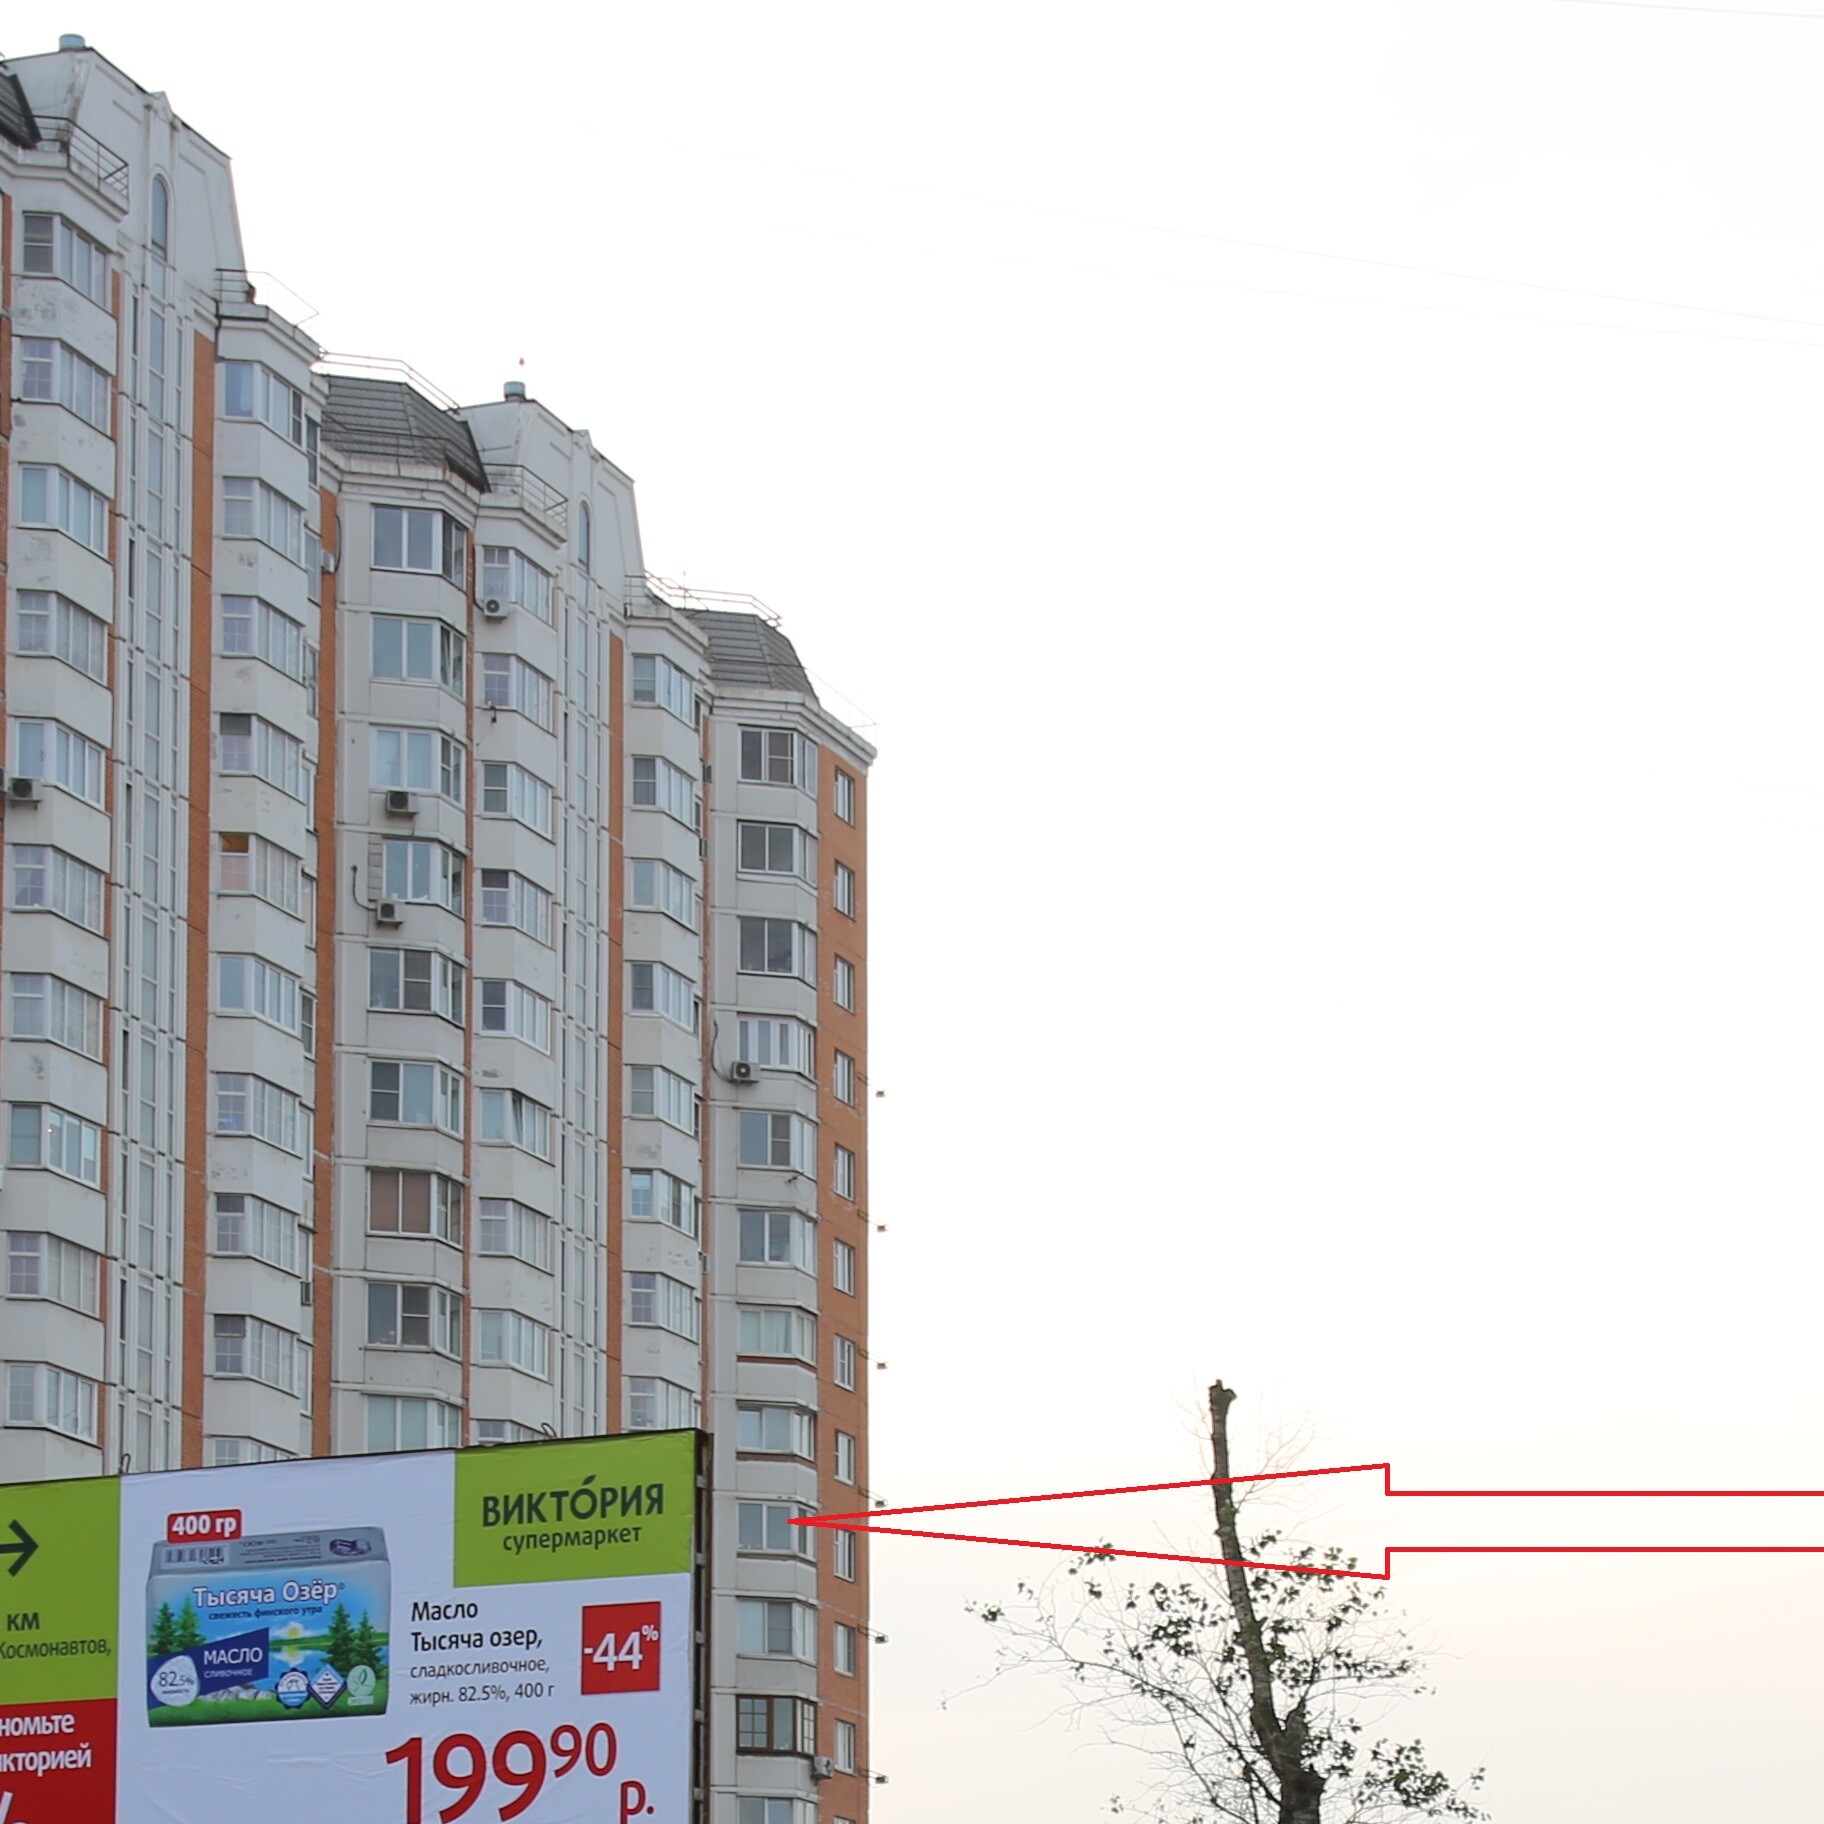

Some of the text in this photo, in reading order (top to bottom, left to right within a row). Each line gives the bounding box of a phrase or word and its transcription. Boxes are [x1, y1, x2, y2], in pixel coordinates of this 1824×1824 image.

[171, 1514, 238, 1538] 400 гр
[502, 1526, 643, 1555] супермаркет
[193, 1578, 338, 1608] Тысяча Озёр
[7, 1611, 41, 1632] км
[208, 1605, 323, 1621] свежесть финского утра
[410, 1601, 479, 1622] Масло
[410, 1628, 543, 1652] Тысяча озер,
[203, 1647, 263, 1666] МАСЛО
[203, 1668, 254, 1679] СЛИВОЧНОЕ
[409, 1658, 550, 1680] сладкосливочное,
[409, 1682, 555, 1708] жирн. 82.5%, 400 г
